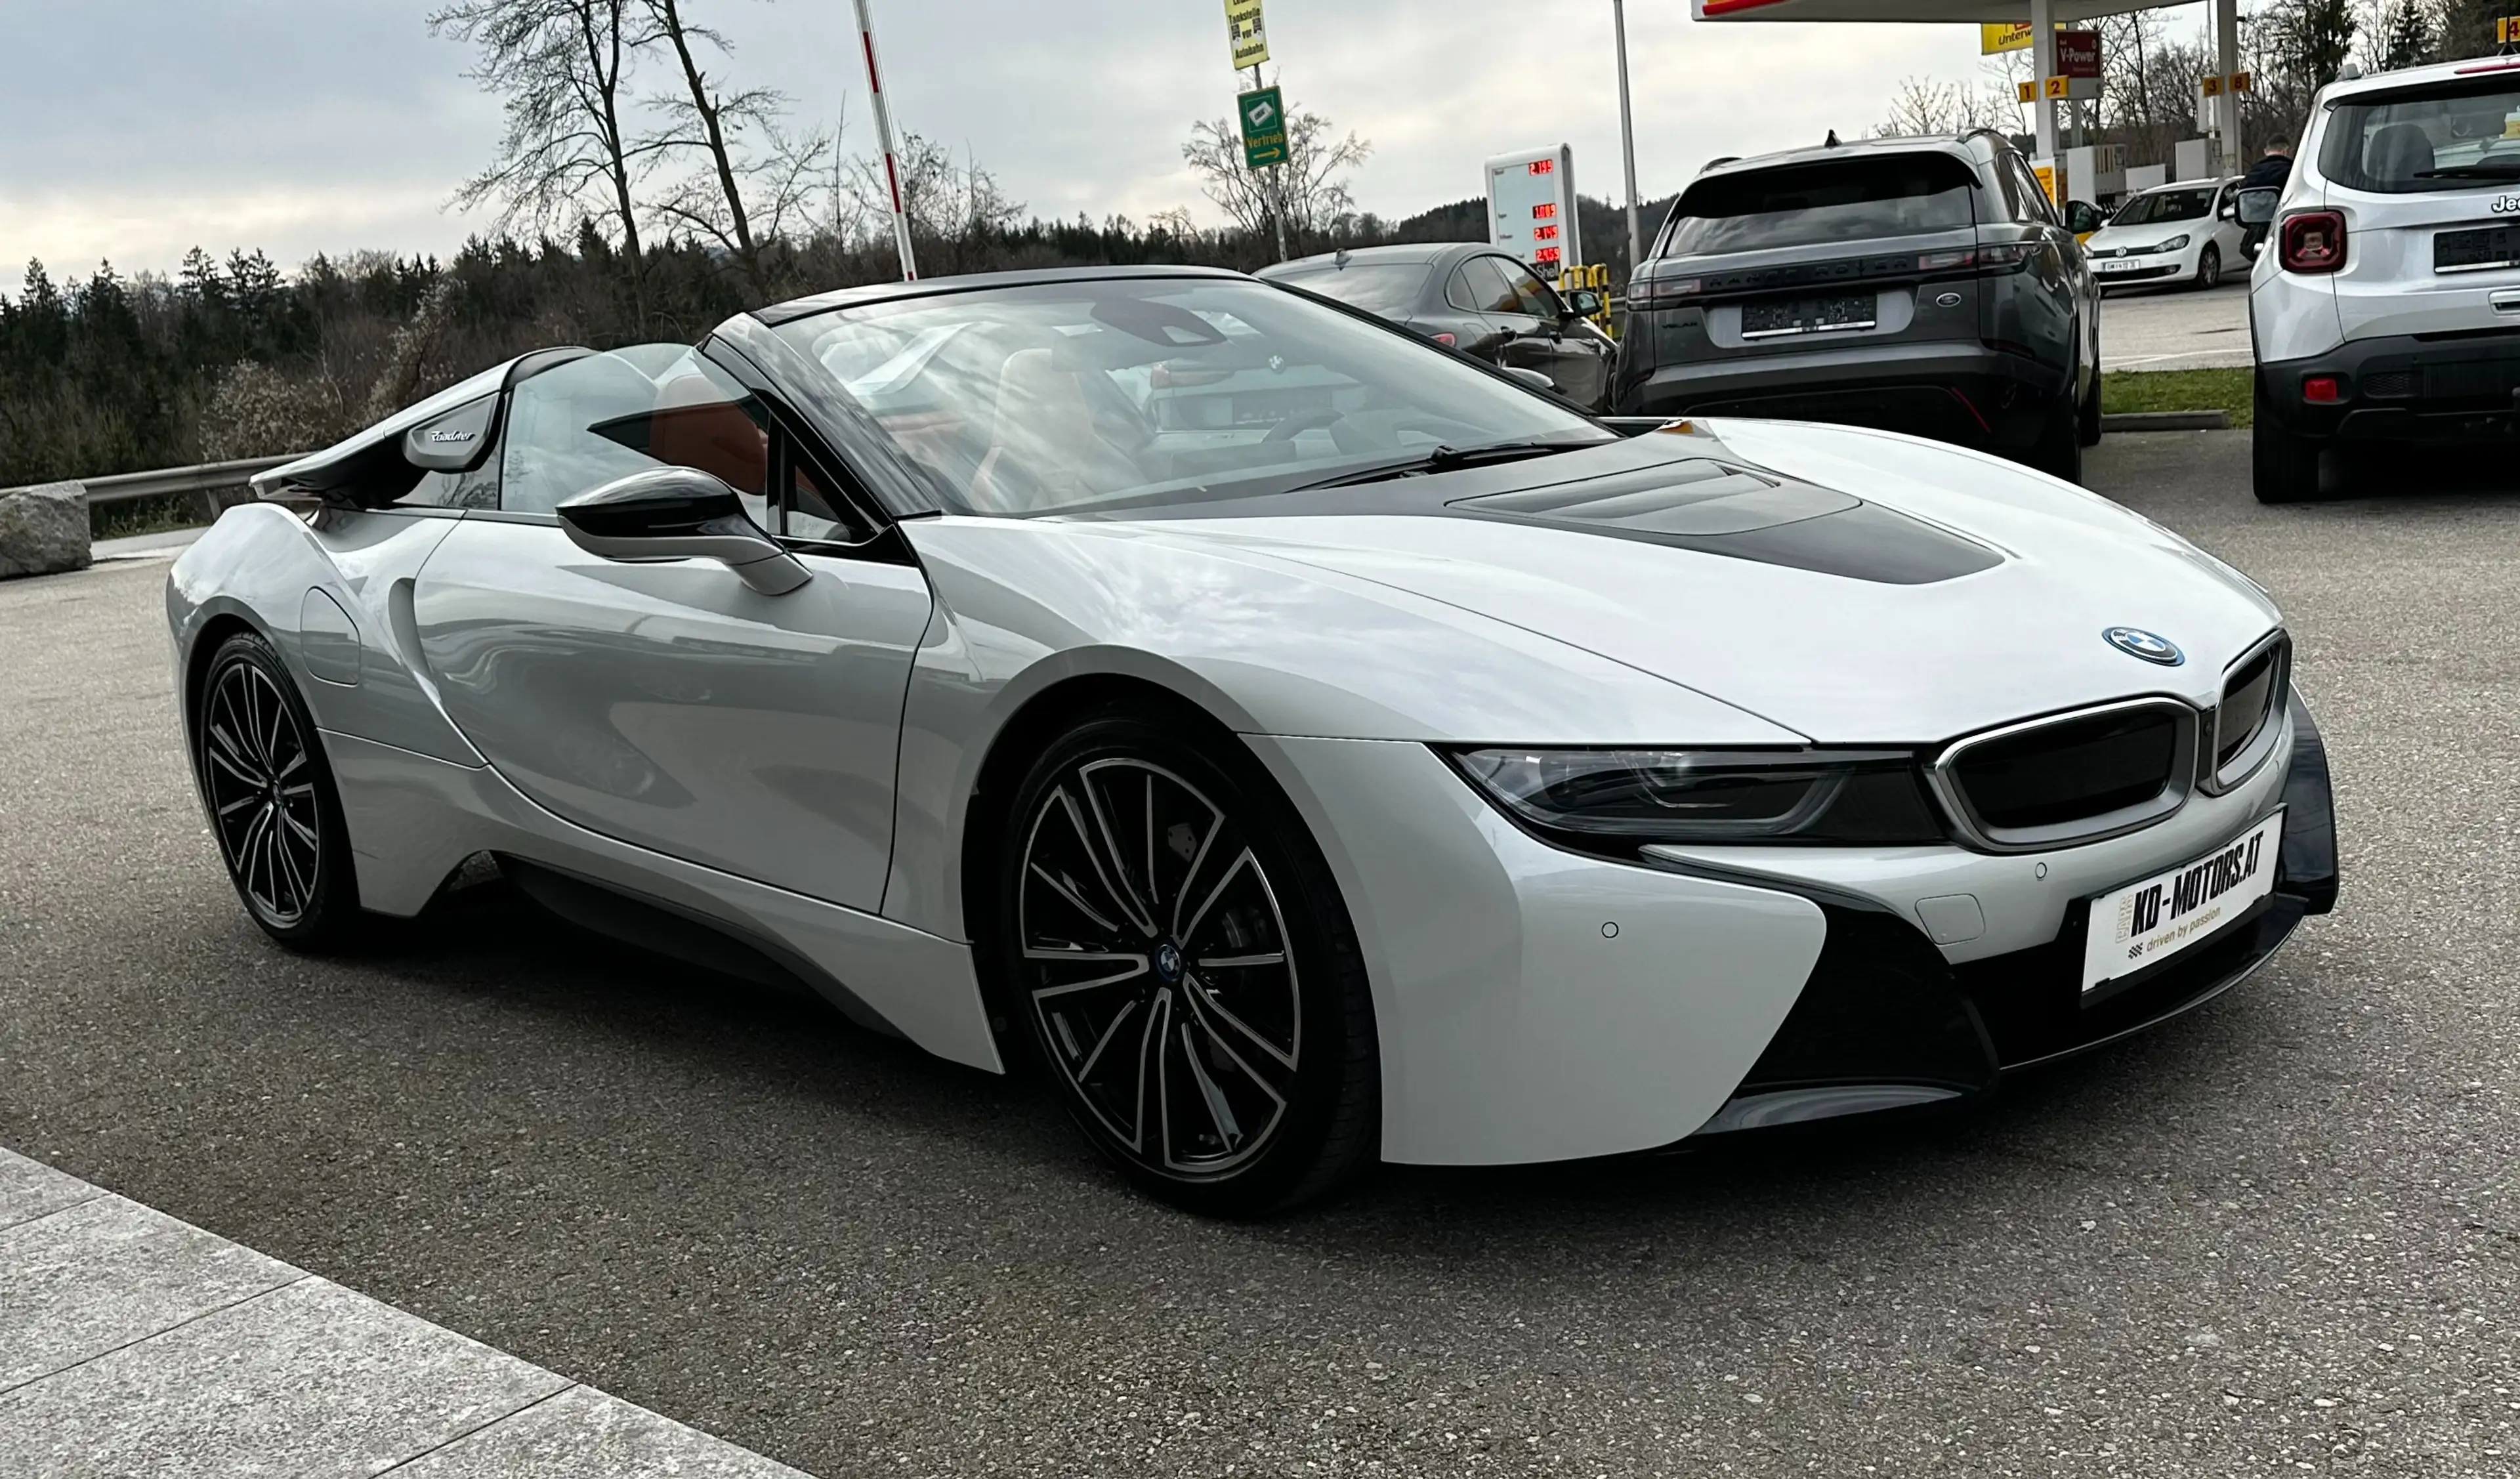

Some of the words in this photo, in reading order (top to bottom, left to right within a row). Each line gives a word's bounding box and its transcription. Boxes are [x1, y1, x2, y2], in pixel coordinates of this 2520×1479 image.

[1228, 7, 1261, 24] Tankstelle
[2510, 21, 2519, 37] 4
[1235, 43, 1265, 59] Autobahn
[2059, 47, 2095, 63] V-Power
[2023, 85, 2030, 98] 1
[2050, 81, 2060, 94] 2
[2208, 79, 2217, 92] 3
[1247, 131, 1284, 149] Vertrieb
[2491, 195, 2520, 213] Je
[1536, 262, 1559, 277] Shell
[2131, 830, 2264, 938] KD-MOTORS.AT
[2147, 930, 2175, 952] driven
[2177, 924, 2189, 938] by
[2189, 906, 2221, 934] passion
